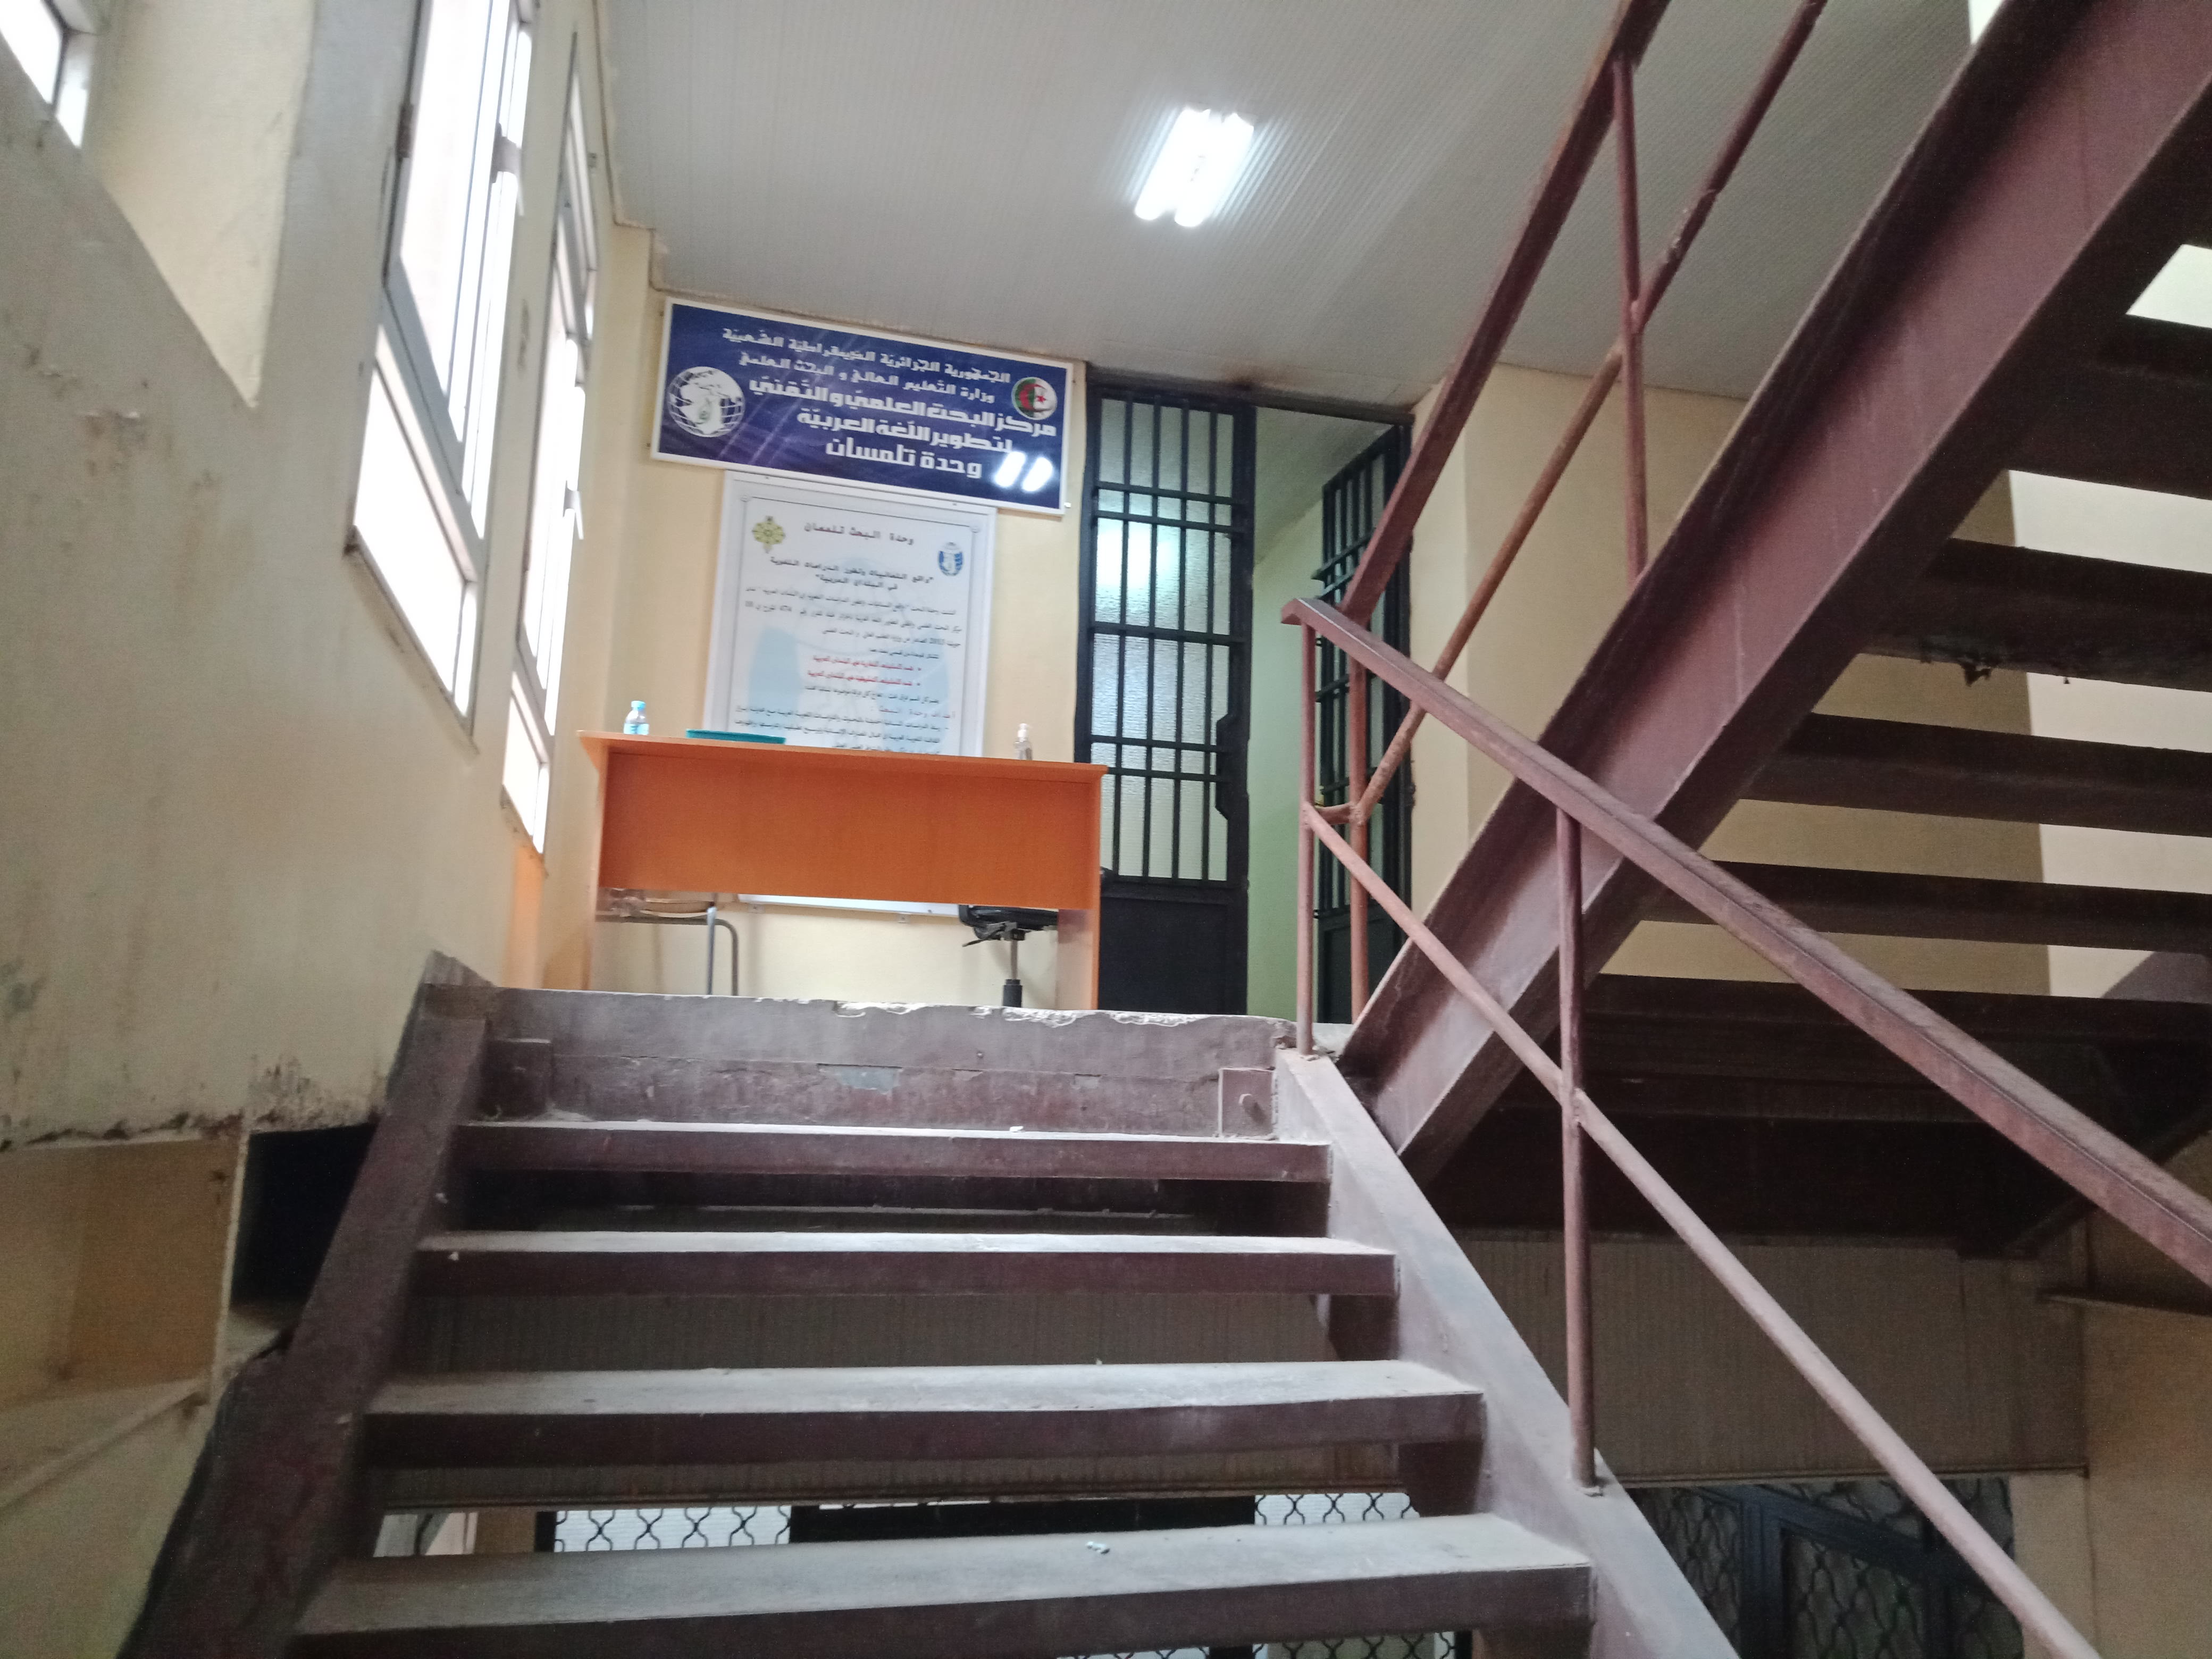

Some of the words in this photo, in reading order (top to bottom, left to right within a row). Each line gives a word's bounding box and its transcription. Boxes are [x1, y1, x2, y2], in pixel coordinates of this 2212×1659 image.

[927, 403, 995, 428] البحث
[995, 413, 1057, 437] مركز
[826, 437, 916, 466] تلمسان
[920, 451, 982, 479] وحدة
